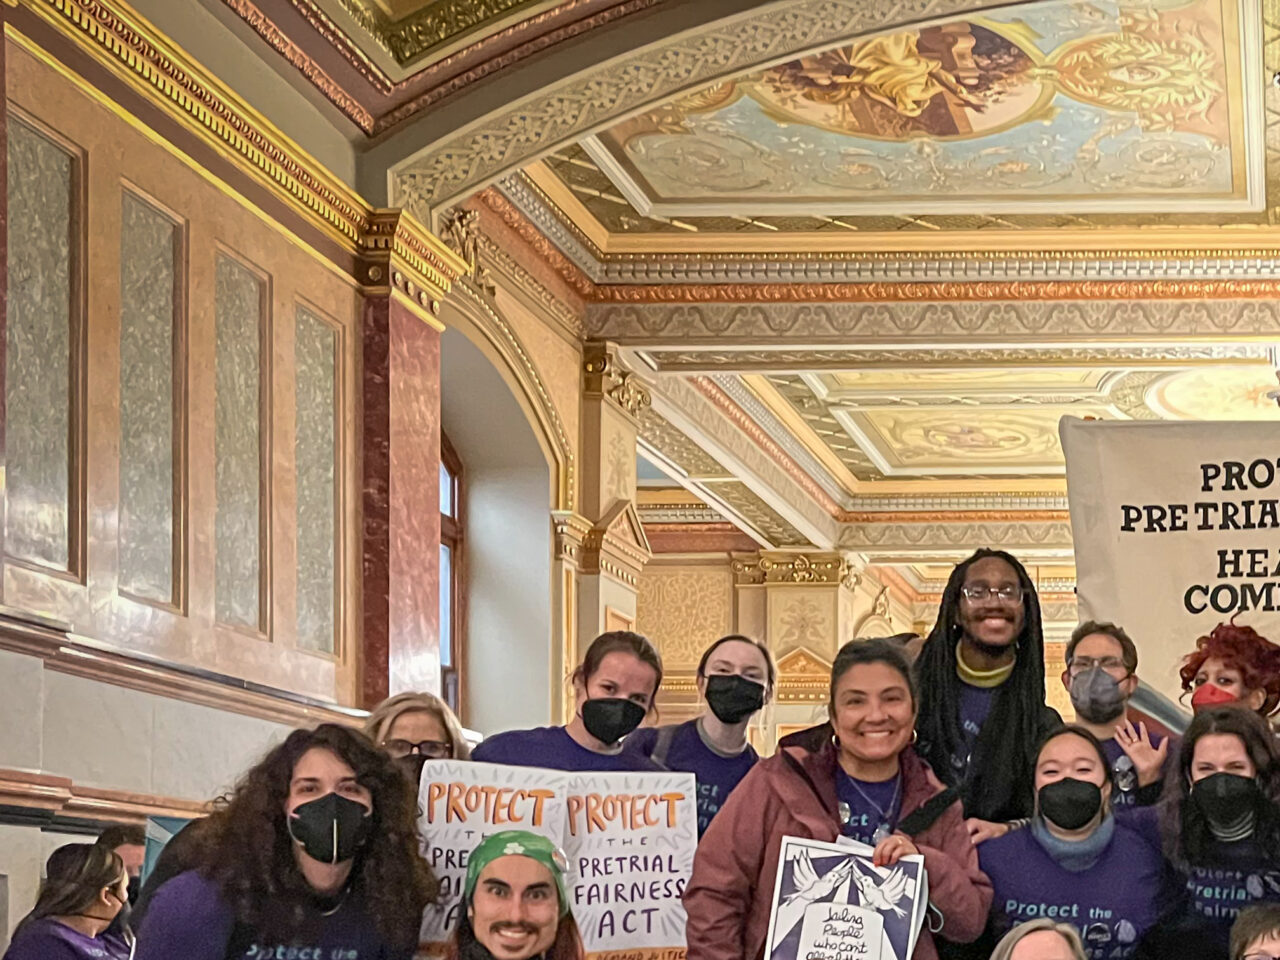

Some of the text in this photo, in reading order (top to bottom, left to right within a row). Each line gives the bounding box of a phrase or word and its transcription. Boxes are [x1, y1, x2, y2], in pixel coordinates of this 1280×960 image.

[428, 781, 554, 827] PROTECT
[567, 792, 686, 837] PROTECT
[608, 836, 649, 846] THE
[579, 854, 681, 879] PRETRIAL
[575, 878, 686, 906] FAIRNESS
[823, 906, 864, 929] Jailing
[1005, 899, 1112, 919] Protect the
[598, 908, 660, 939] ACT
[823, 924, 865, 940] People
[813, 938, 838, 951] who
